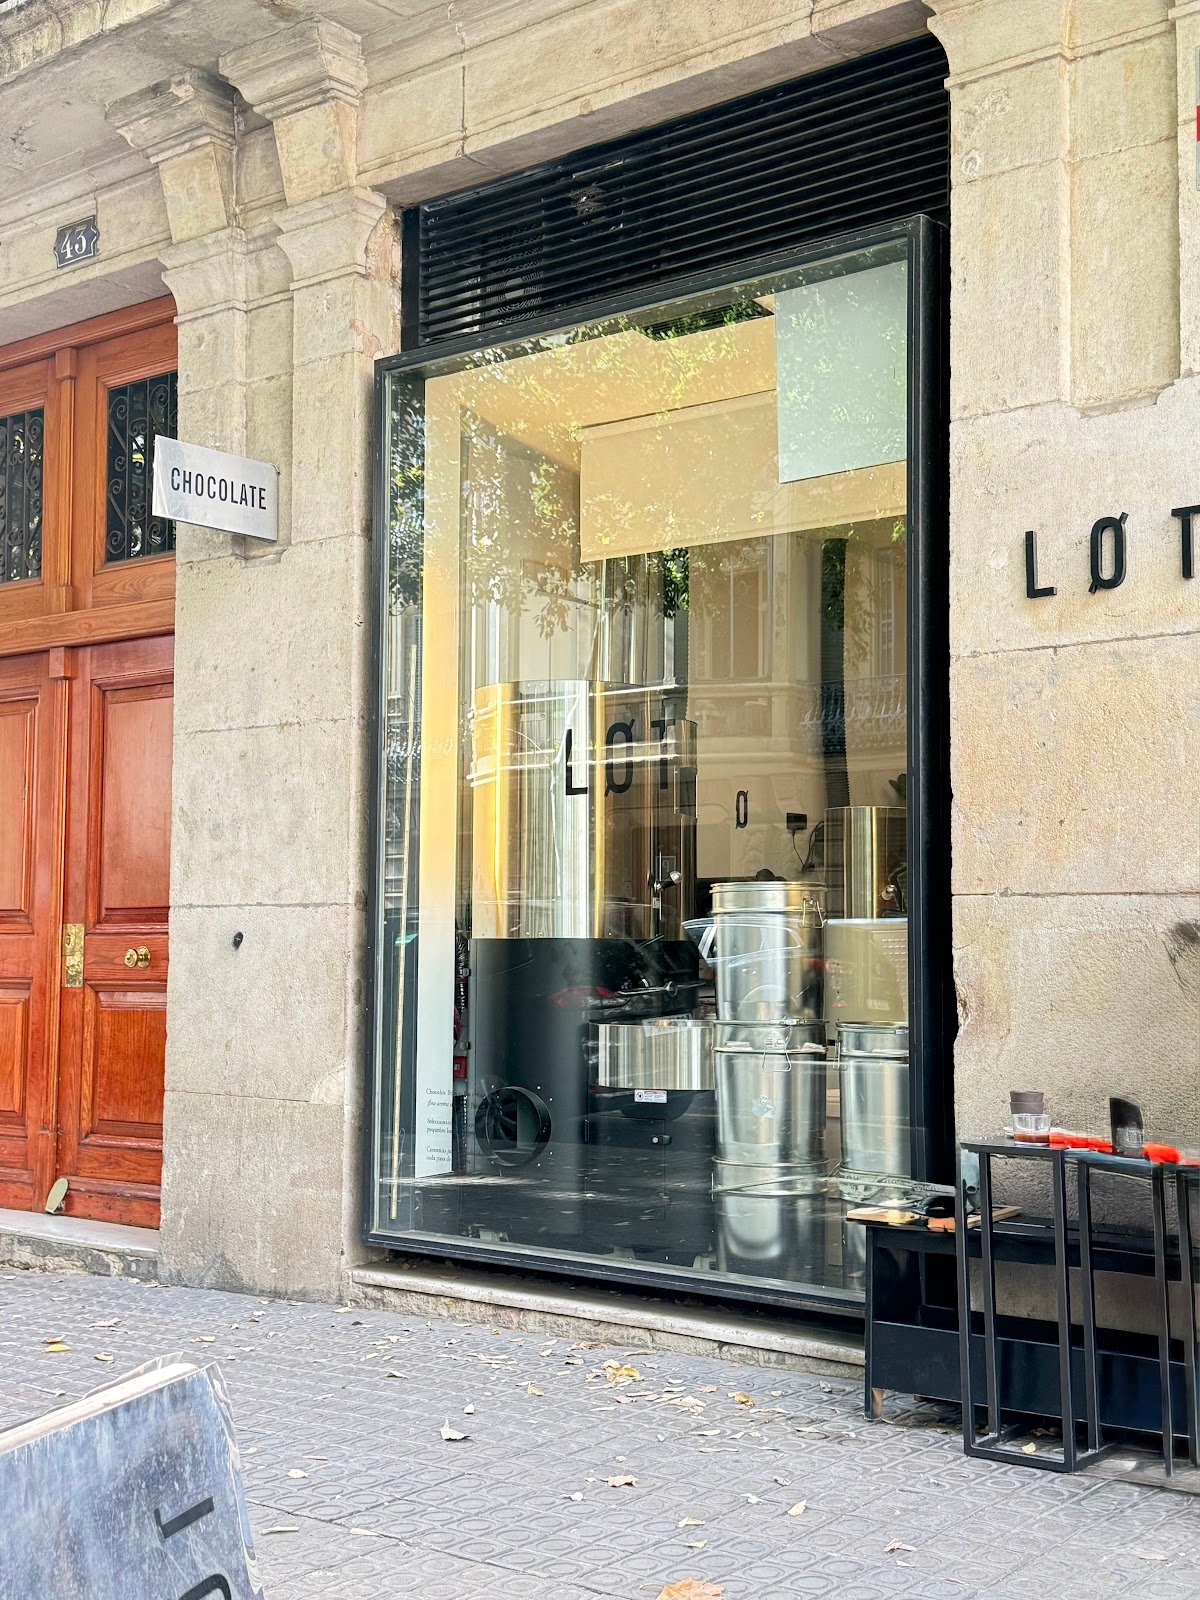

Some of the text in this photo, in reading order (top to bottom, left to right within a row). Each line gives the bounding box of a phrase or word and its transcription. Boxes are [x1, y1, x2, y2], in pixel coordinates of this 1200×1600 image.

[61, 225, 87, 259] 43
[171, 468, 266, 510] CHOCOLATE
[1025, 504, 1200, 598] LØT
[565, 719, 675, 797] LØT
